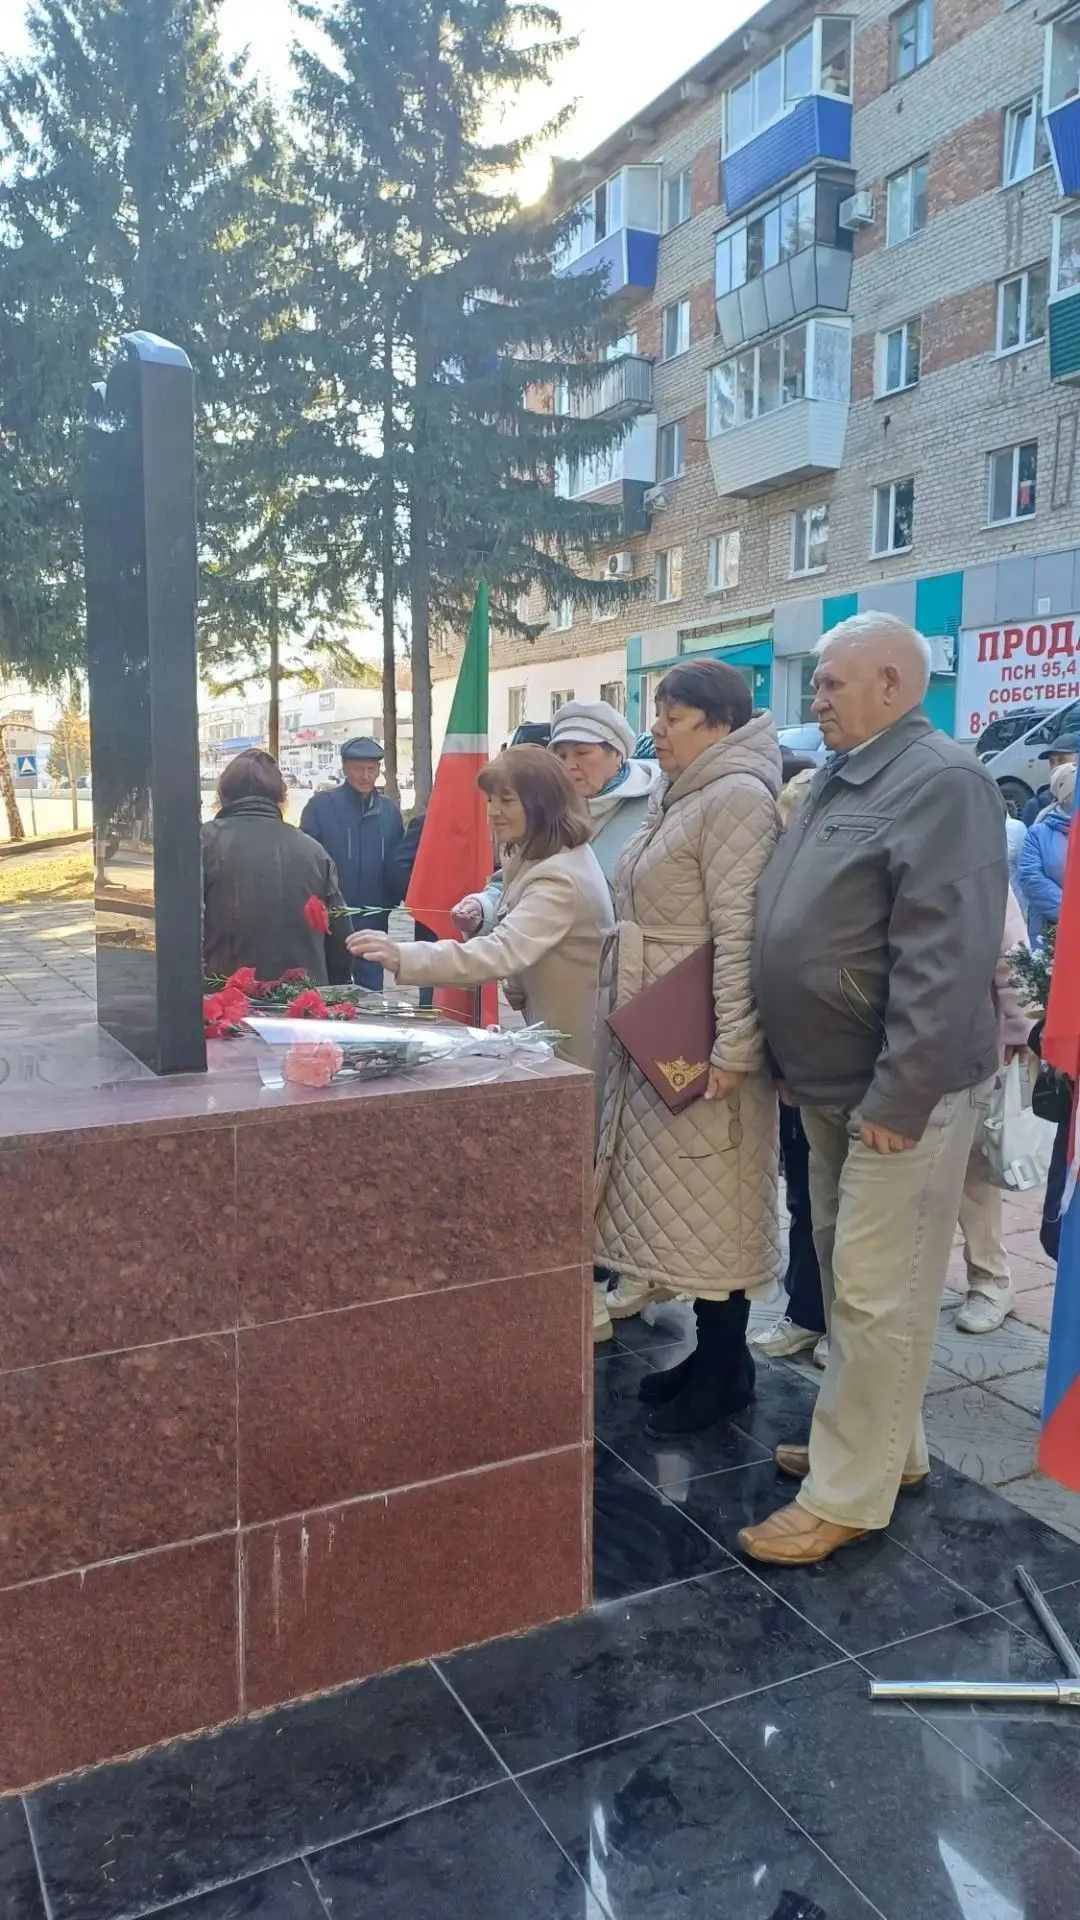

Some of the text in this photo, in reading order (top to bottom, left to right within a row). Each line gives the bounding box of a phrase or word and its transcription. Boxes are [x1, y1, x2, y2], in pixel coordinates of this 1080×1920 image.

[977, 620, 1080, 662] ПРОД
[1001, 660, 1076, 681] ПСН 95,4
